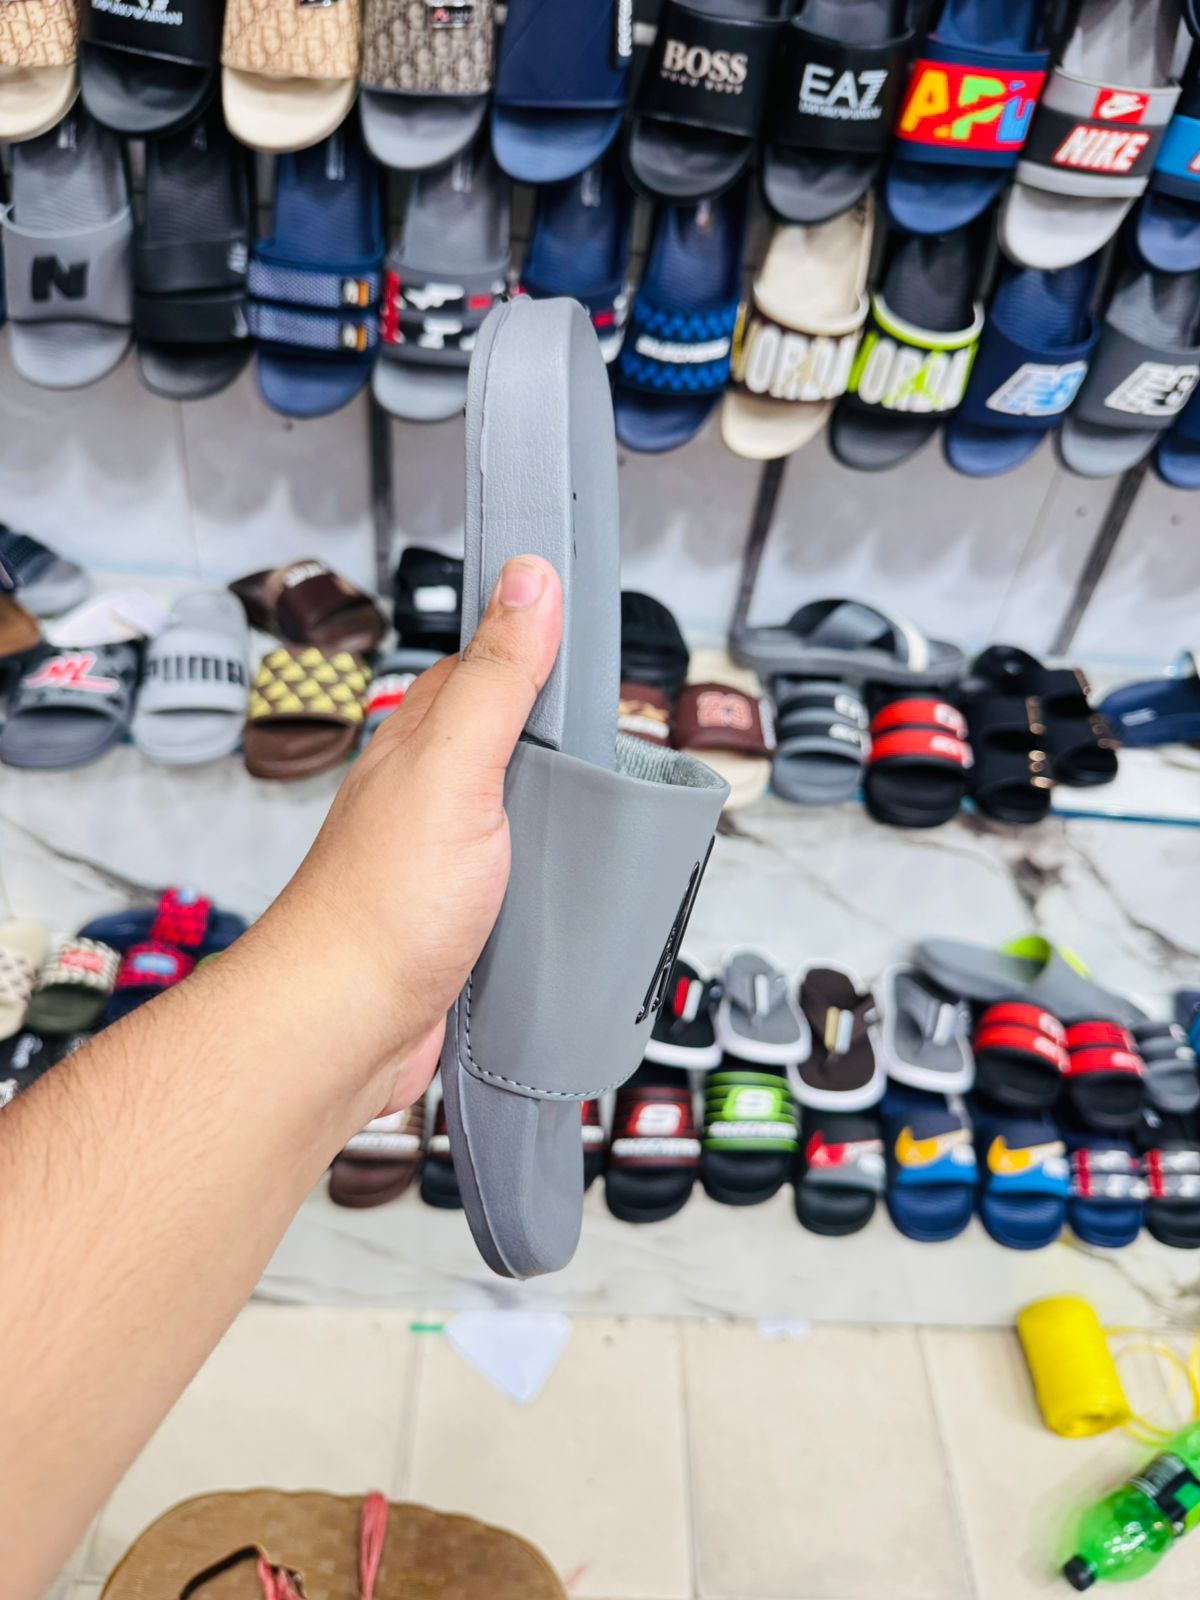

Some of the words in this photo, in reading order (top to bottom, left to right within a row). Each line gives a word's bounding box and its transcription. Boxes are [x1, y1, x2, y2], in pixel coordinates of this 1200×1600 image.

[663, 39, 748, 85] BOSS
[799, 63, 889, 110] EA7
[1053, 125, 1151, 173] NIKE
[31, 255, 88, 303] N
